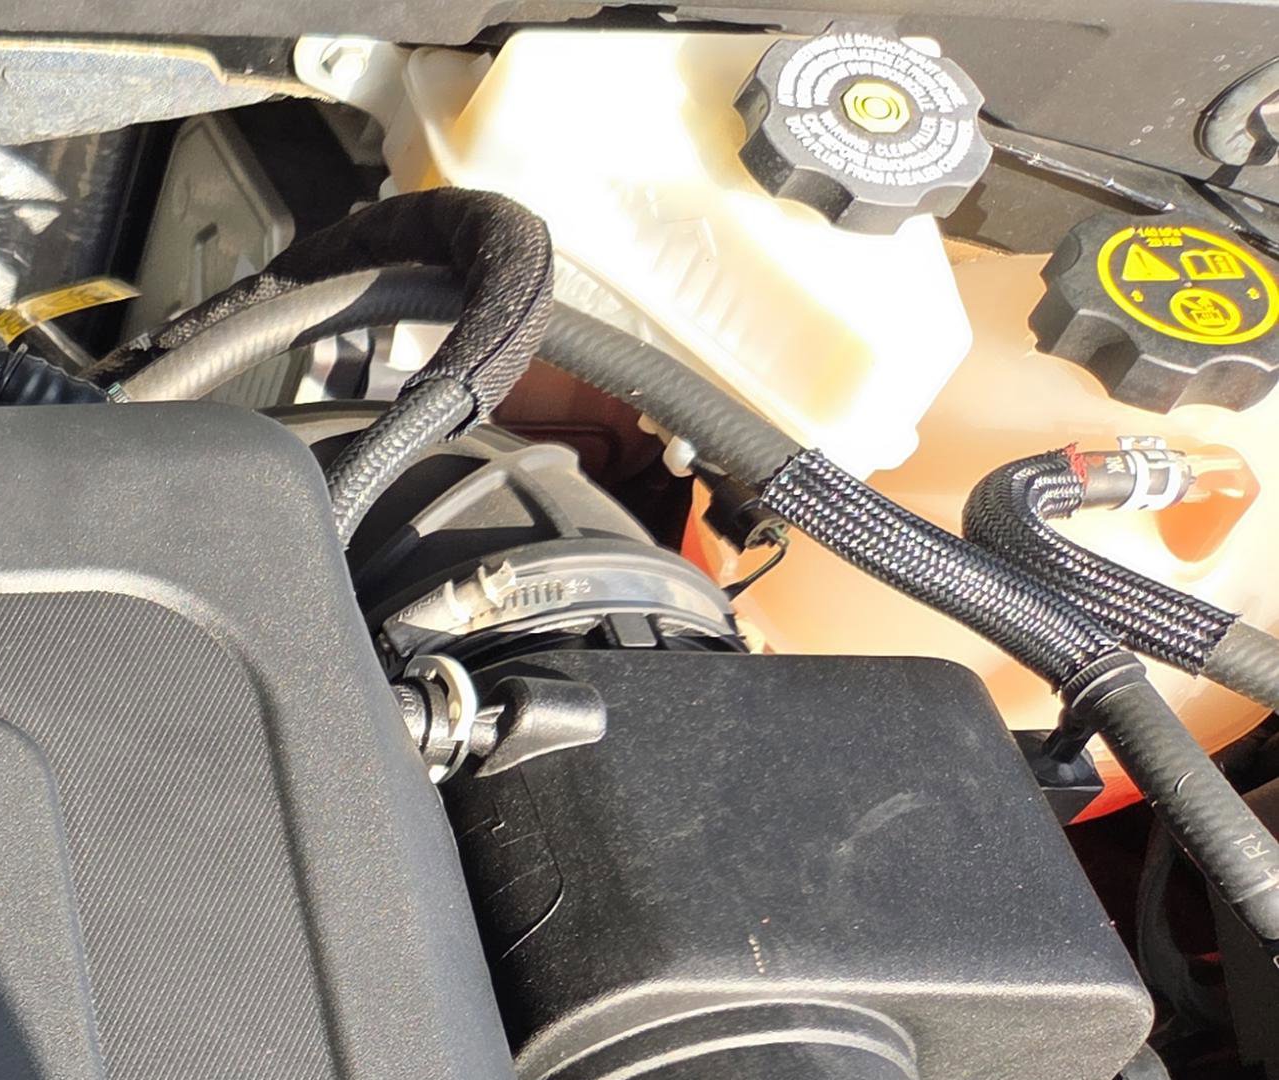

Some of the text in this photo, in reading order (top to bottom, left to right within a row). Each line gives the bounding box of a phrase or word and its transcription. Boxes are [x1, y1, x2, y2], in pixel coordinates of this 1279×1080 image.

[802, 113, 826, 135] CAP
[808, 142, 845, 170] FLUID
[844, 162, 884, 184] FROM
